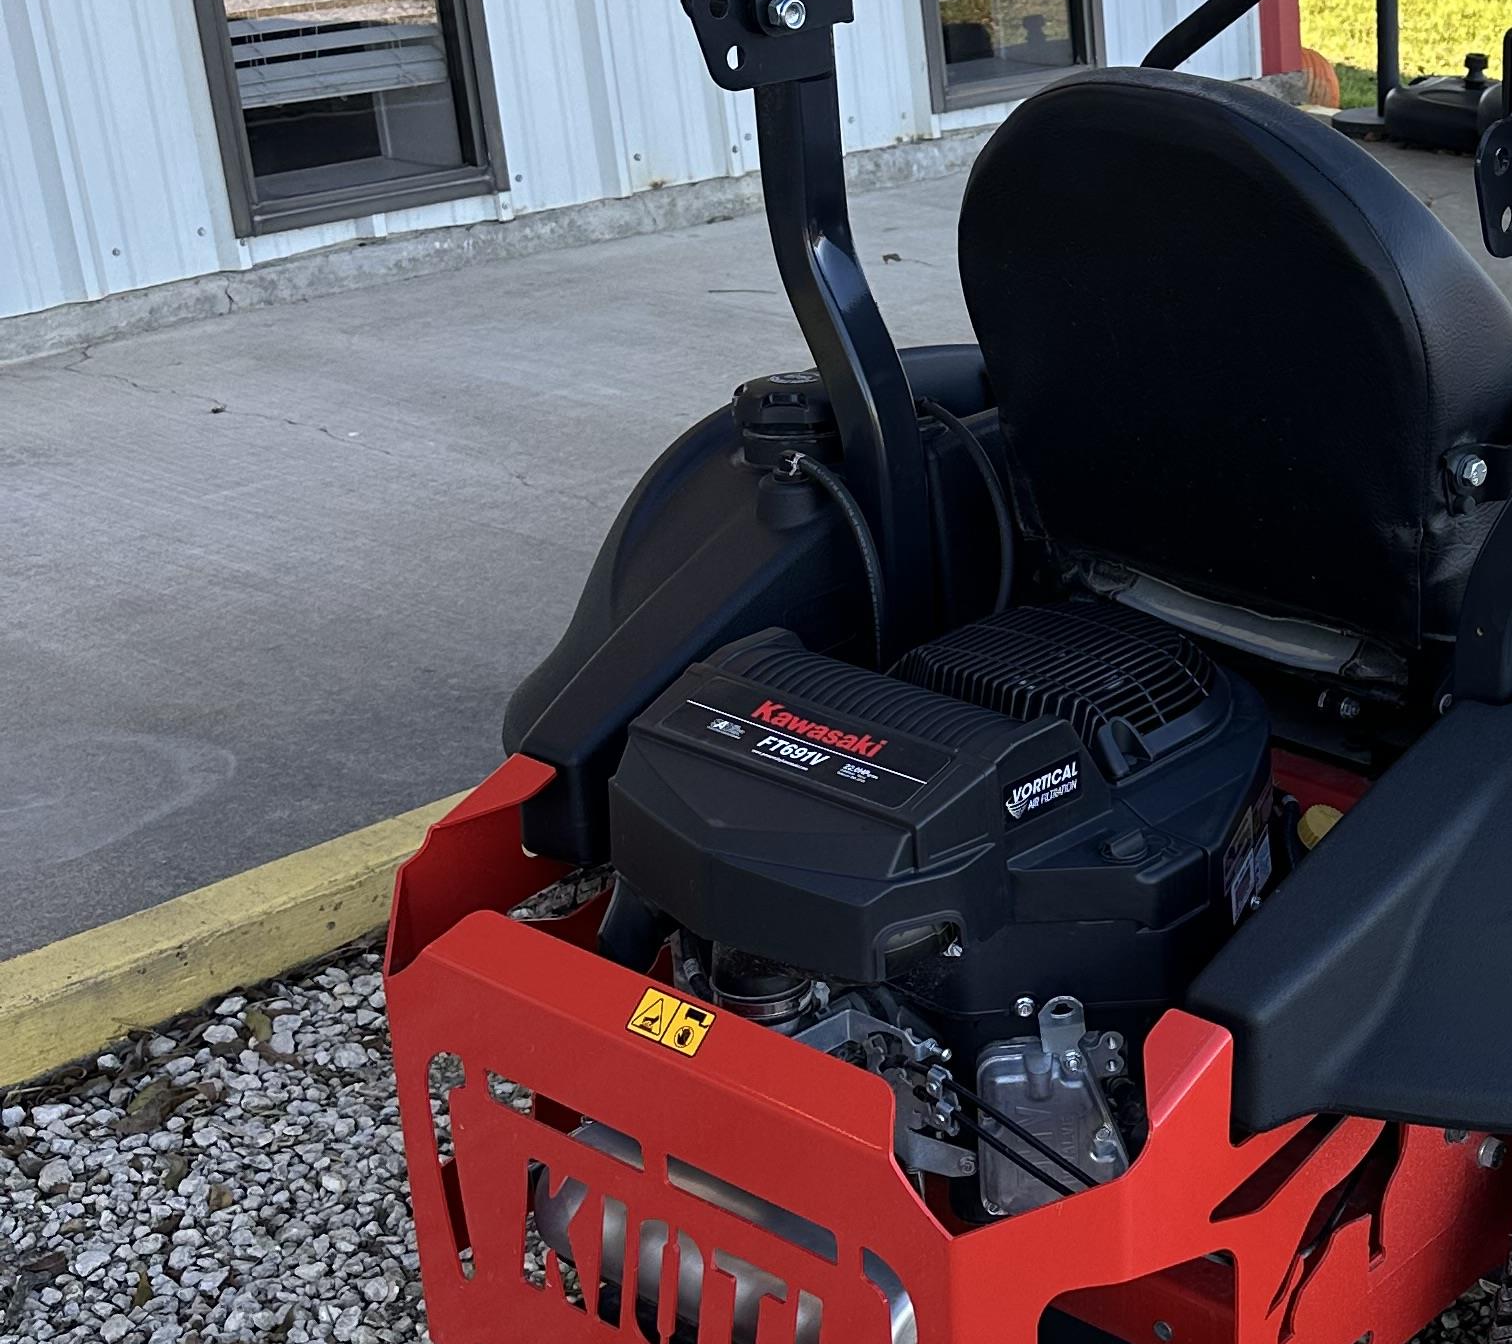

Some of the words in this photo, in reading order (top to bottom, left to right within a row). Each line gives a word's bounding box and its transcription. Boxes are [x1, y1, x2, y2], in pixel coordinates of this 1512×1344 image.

[751, 699, 888, 758] Kawasaki
[756, 735, 831, 766] FT691V
[1012, 760, 1078, 803] VORTICAL
[1027, 796, 1040, 811] AIR
